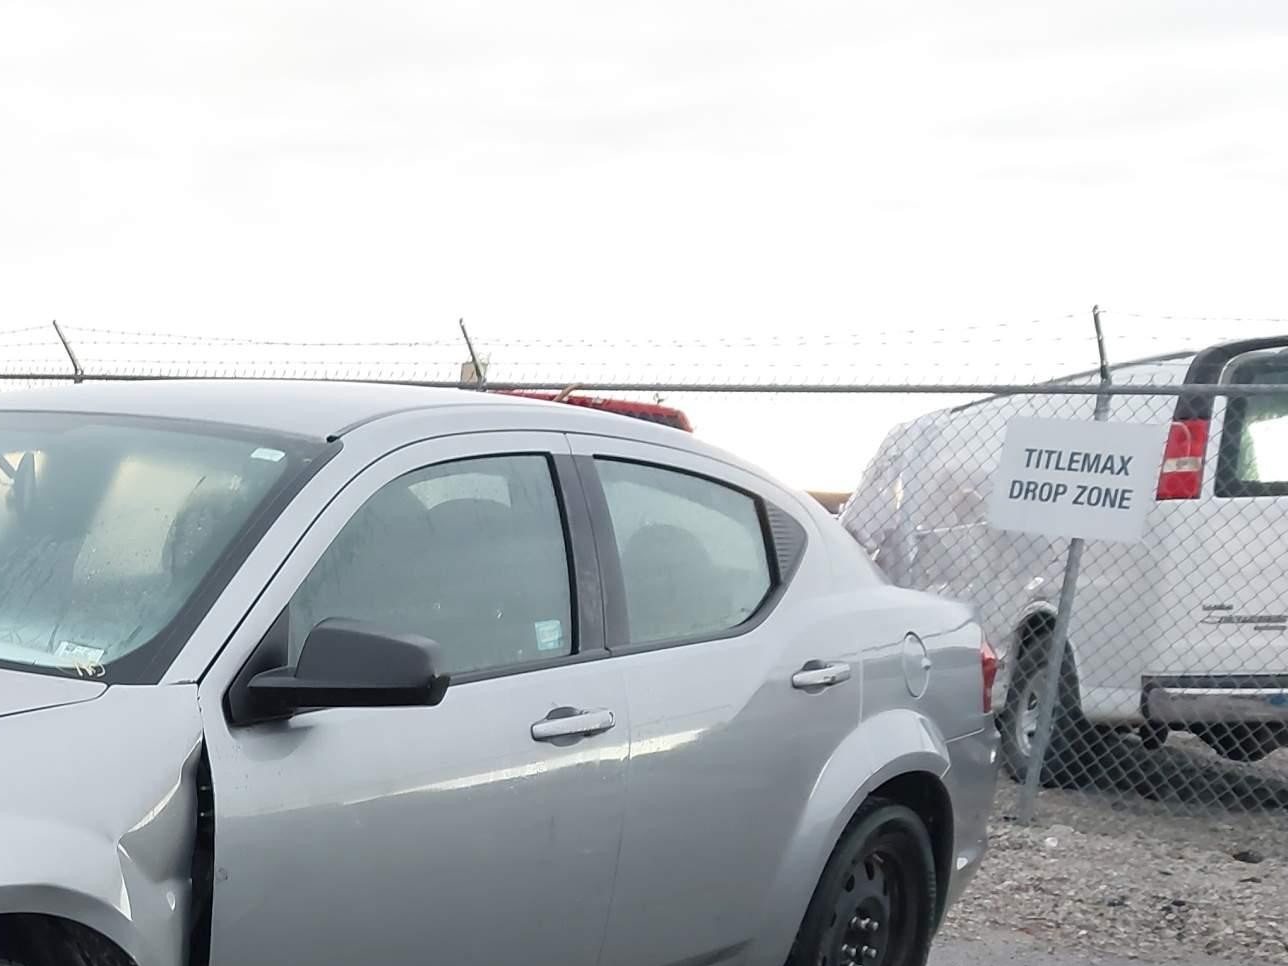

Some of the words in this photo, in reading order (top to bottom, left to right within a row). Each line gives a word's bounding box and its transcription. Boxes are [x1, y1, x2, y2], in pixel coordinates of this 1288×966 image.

[1025, 448, 1133, 476] TITLEMAX
[1008, 480, 1068, 503] DROP
[1072, 485, 1133, 510] ZONE
